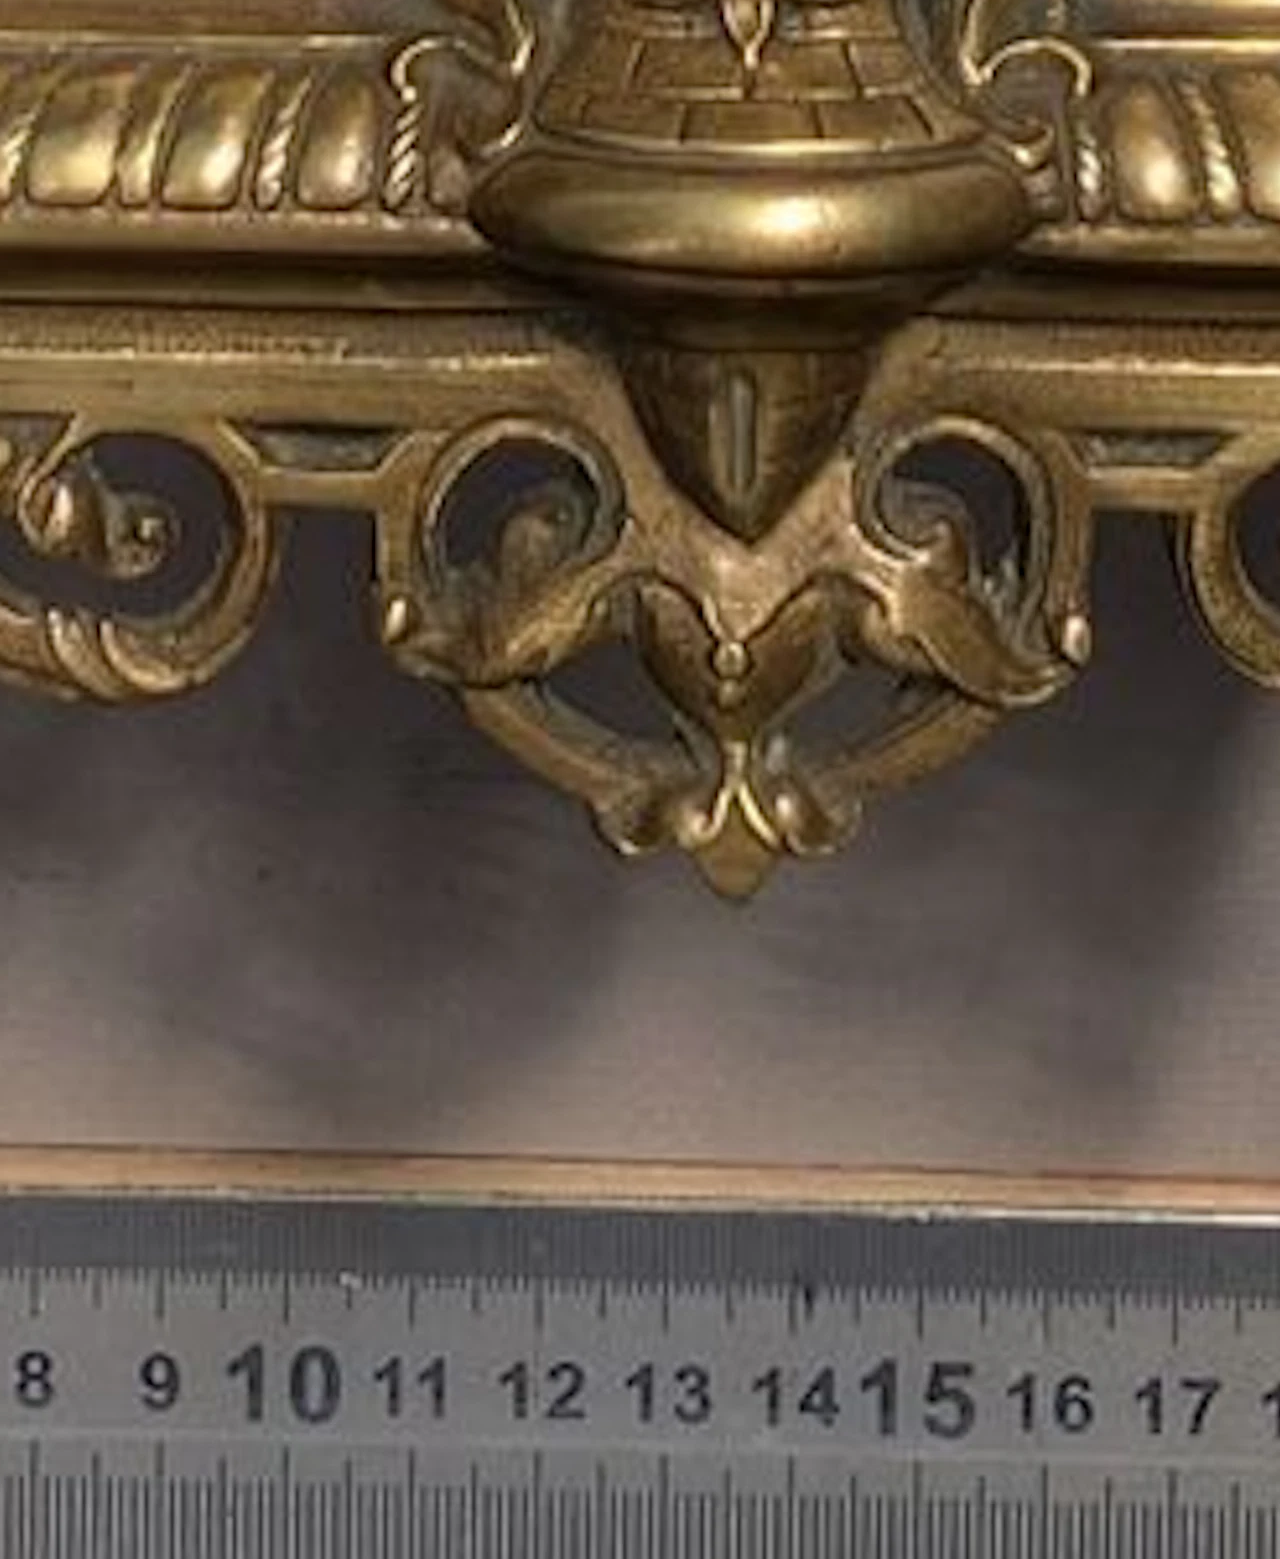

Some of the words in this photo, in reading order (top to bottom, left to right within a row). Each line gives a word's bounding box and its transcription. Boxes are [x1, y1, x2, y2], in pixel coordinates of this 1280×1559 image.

[16, 1351, 54, 1408] 8
[140, 1352, 180, 1410] 9
[227, 1344, 340, 1423] 10
[374, 1357, 444, 1417] 11
[499, 1362, 585, 1419] 12
[625, 1364, 712, 1423] 13
[753, 1368, 840, 1426] 14
[861, 1360, 974, 1438] 15
[1007, 1374, 1093, 1433] 16
[1135, 1378, 1222, 1435] 17
